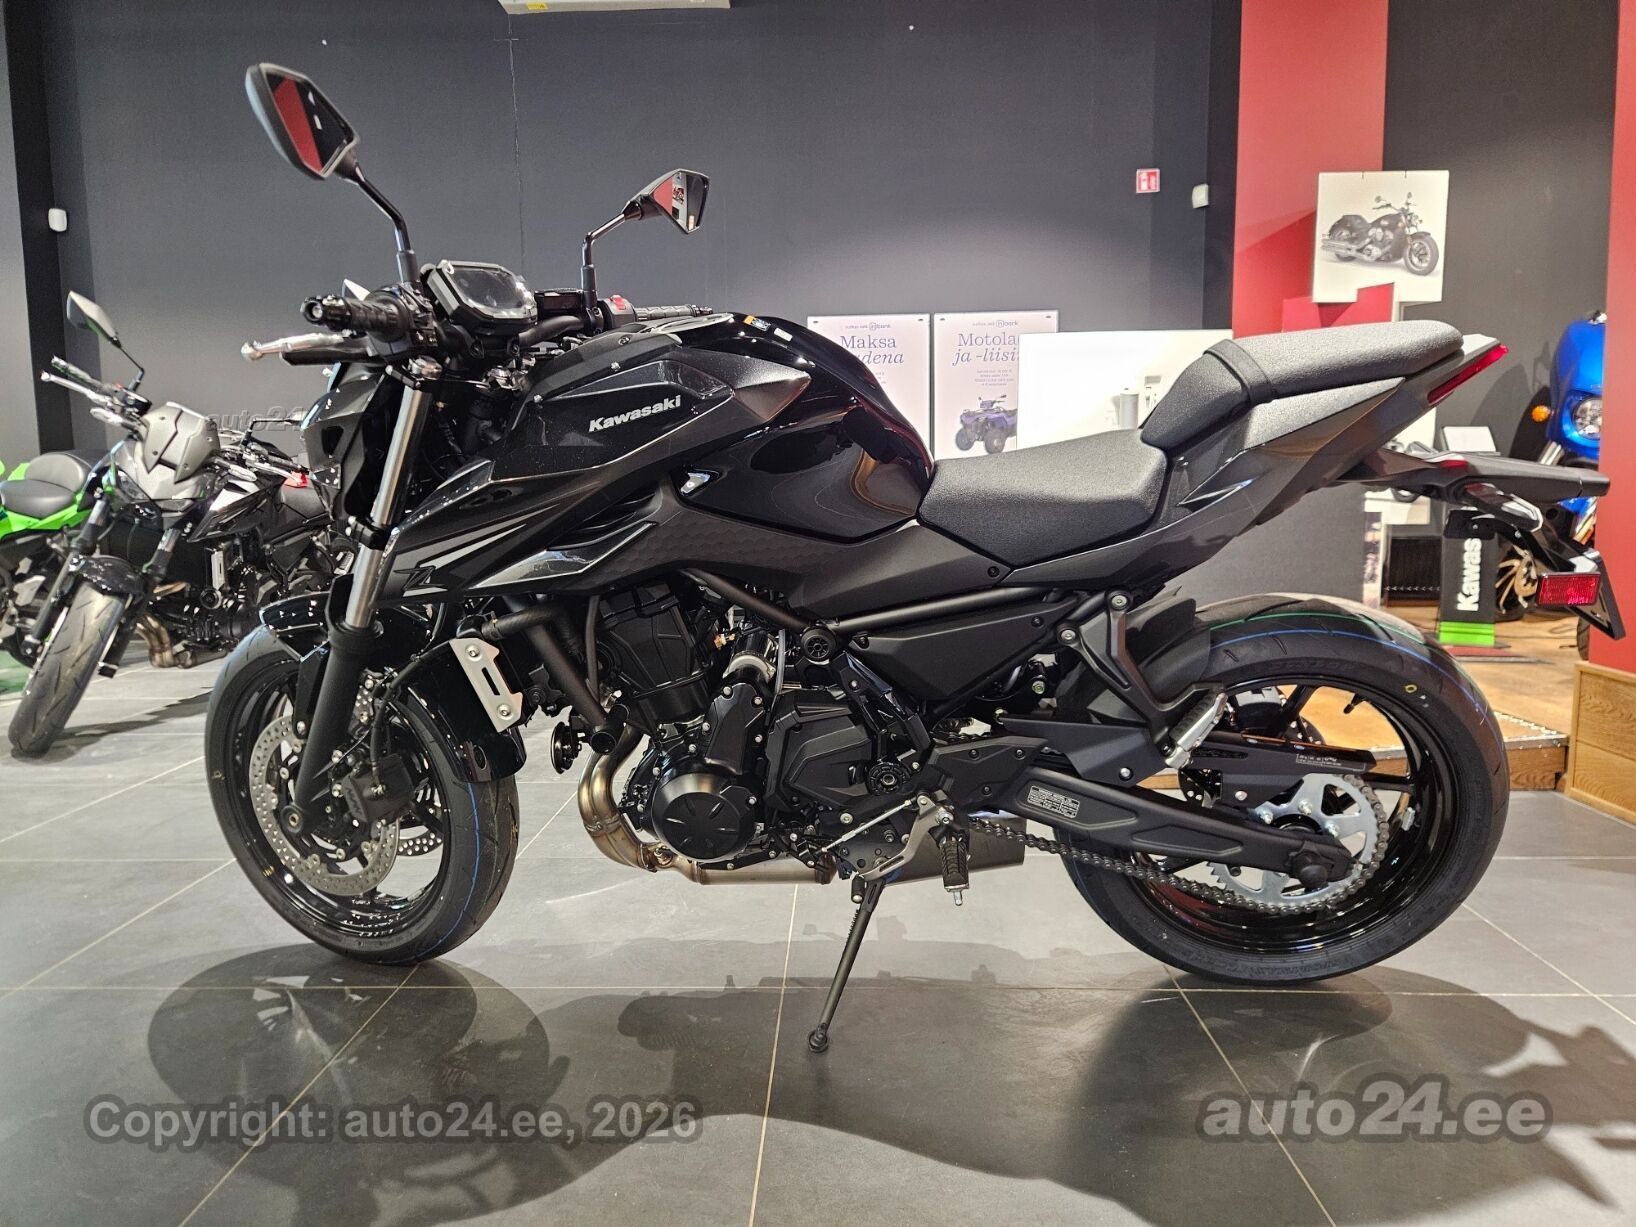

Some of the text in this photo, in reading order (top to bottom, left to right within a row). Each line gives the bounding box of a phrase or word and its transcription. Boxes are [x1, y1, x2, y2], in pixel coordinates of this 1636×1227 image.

[840, 335, 897, 349] Maksa
[958, 332, 1019, 347] Motola
[857, 351, 904, 364] dena
[952, 347, 1019, 366] ja -liisi
[588, 395, 682, 432] Kawasaki
[1456, 537, 1482, 611] Kawas
